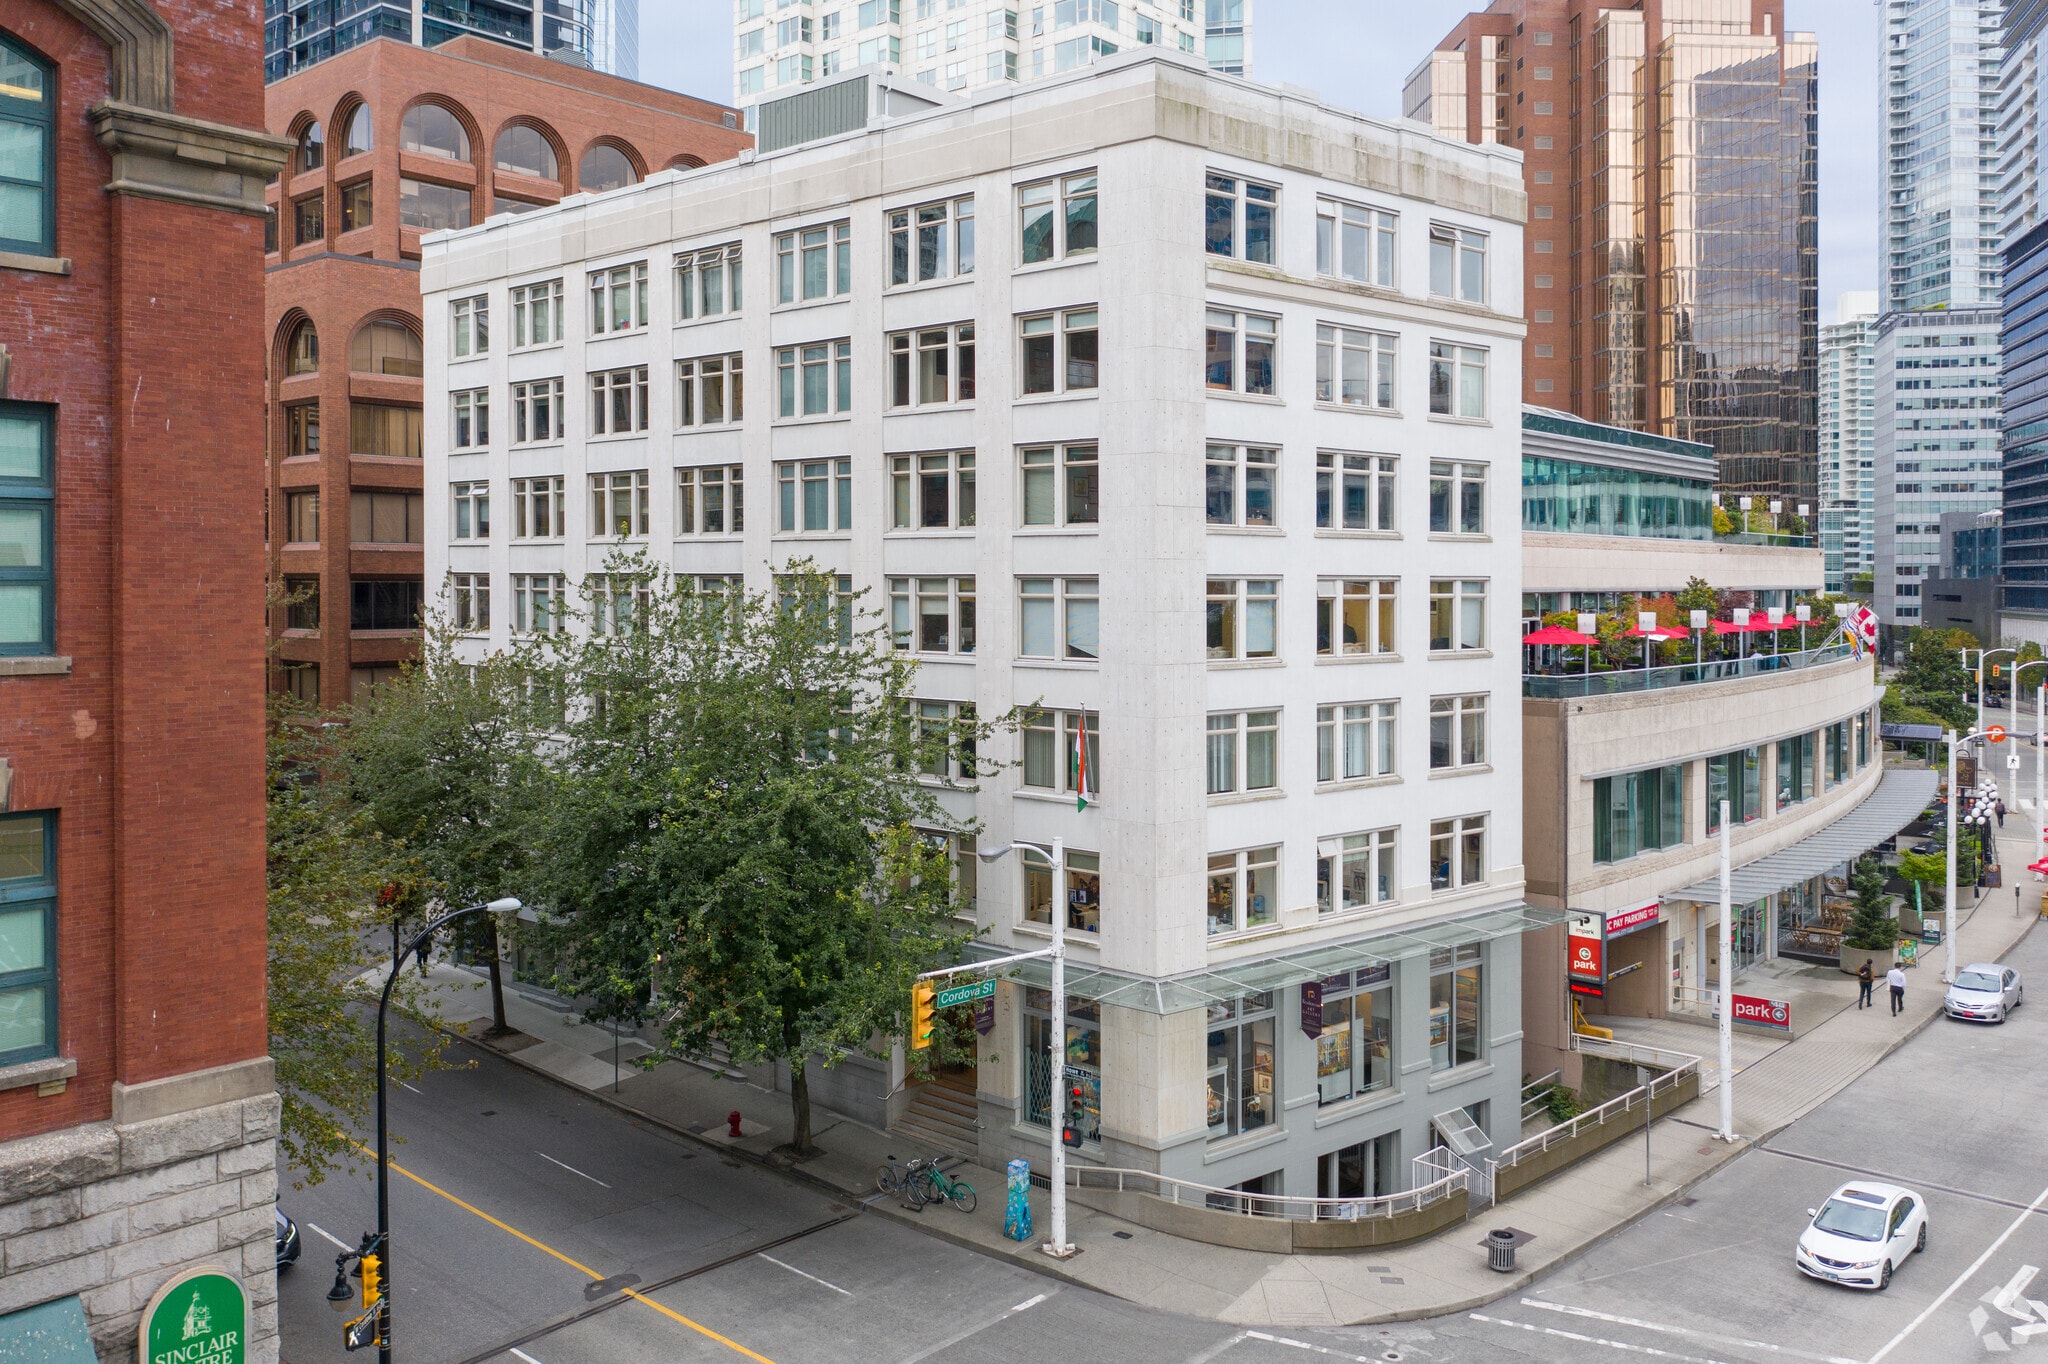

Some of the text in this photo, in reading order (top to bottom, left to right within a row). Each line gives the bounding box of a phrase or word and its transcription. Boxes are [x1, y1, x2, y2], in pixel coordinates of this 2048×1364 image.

[1613, 917, 1624, 929] PAY
[1624, 909, 1648, 926] PARKING
[1575, 927, 1595, 935] impark
[1573, 960, 1597, 971] park
[941, 982, 994, 1004] Cordova St
[1735, 1003, 1770, 1019] park
[155, 1331, 239, 1364] SINCLAIR
